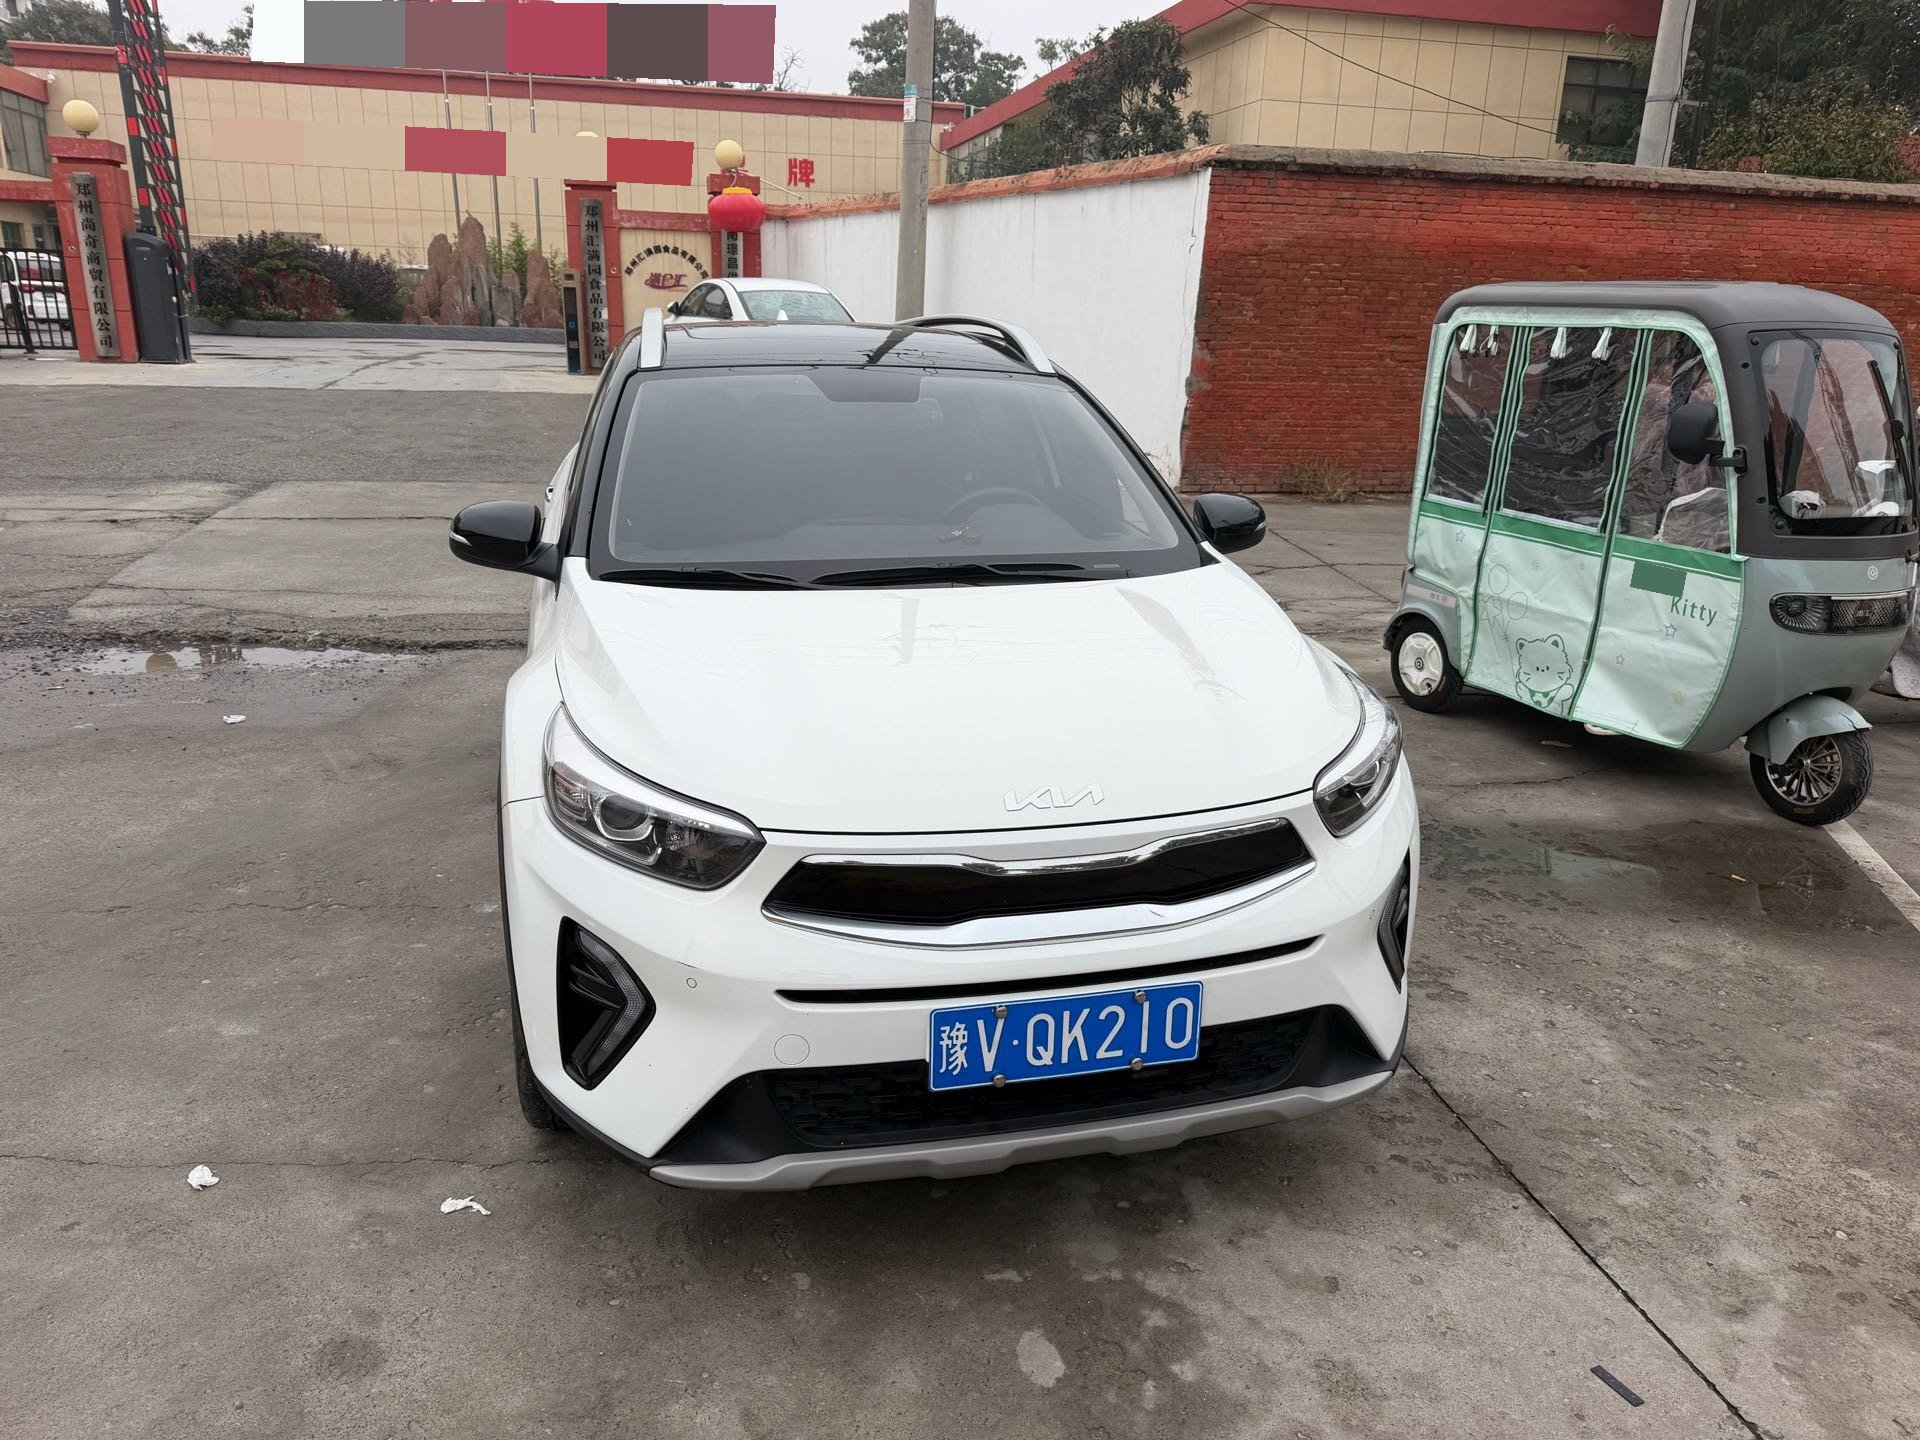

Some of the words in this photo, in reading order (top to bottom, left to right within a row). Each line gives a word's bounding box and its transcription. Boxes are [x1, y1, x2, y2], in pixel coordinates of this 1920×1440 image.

[787, 157, 815, 188] 牌
[624, 244, 709, 280] 郑州汇满园食品有限公司
[584, 203, 607, 362] 郑州汇满园食品有限公司
[1669, 596, 1718, 628] Kitty
[1002, 783, 1105, 812] KIA
